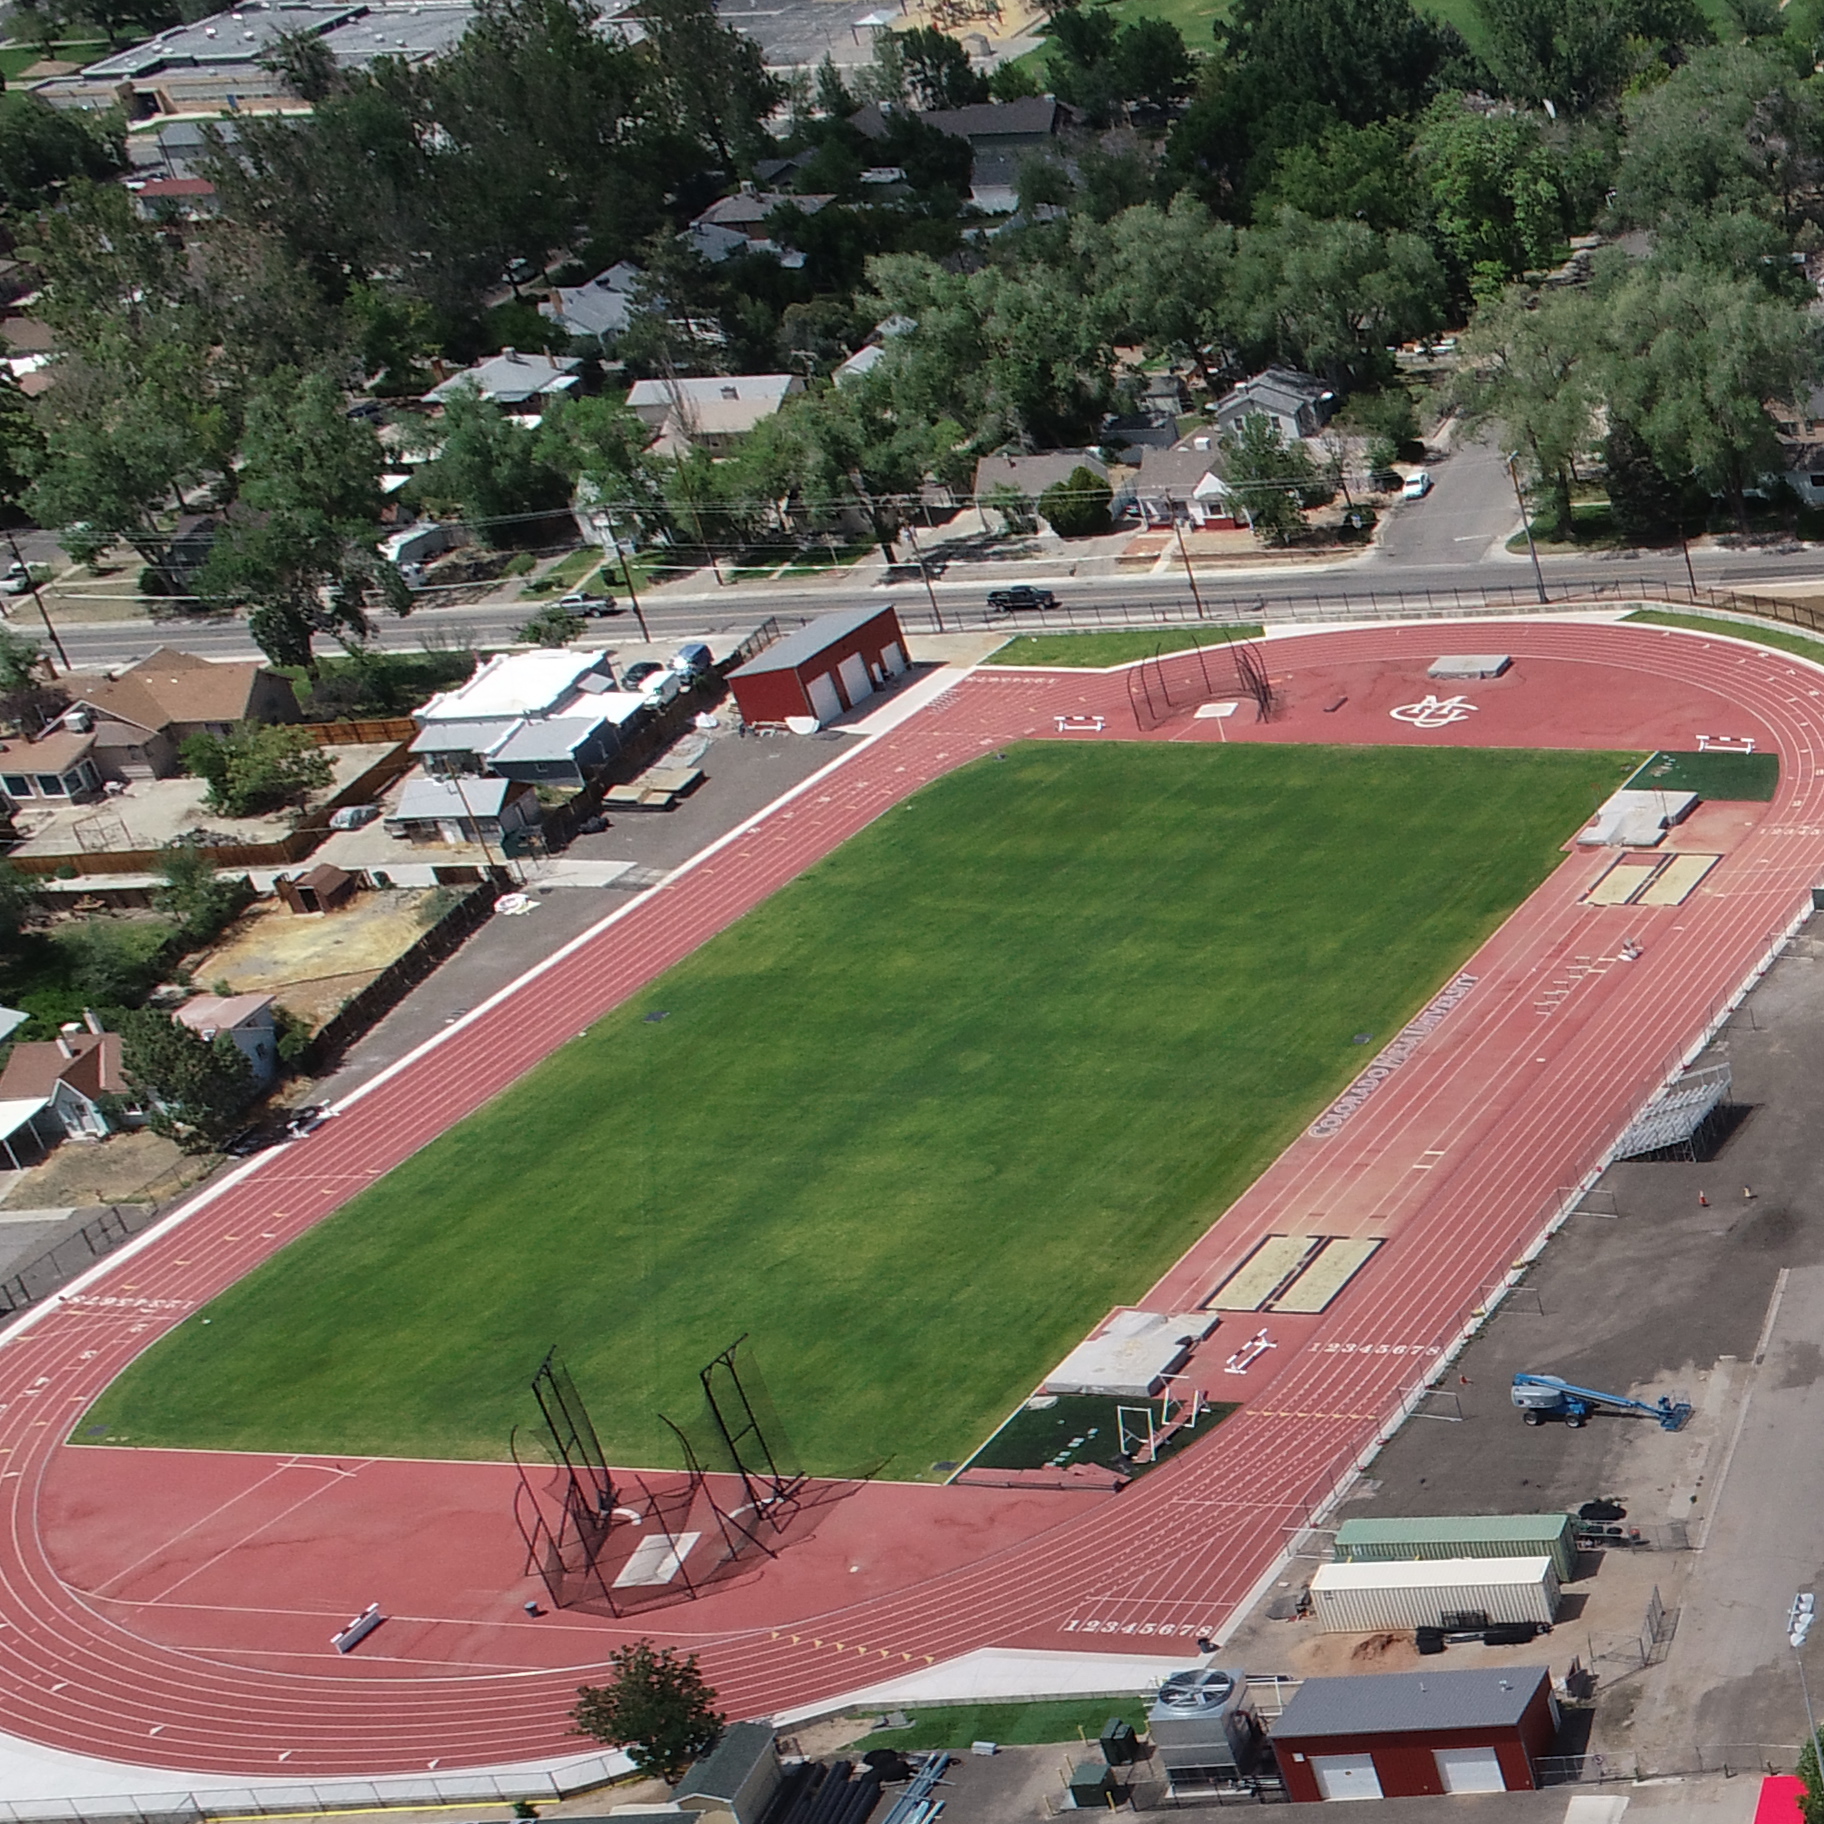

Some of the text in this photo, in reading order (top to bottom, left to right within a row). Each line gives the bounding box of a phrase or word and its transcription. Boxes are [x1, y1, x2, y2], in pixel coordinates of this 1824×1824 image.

[1308, 1343, 1441, 1356] 1 2 3 4 5 6 7 8
[1064, 1620, 1213, 1637] 1 2 3 4 5 6 7 8
